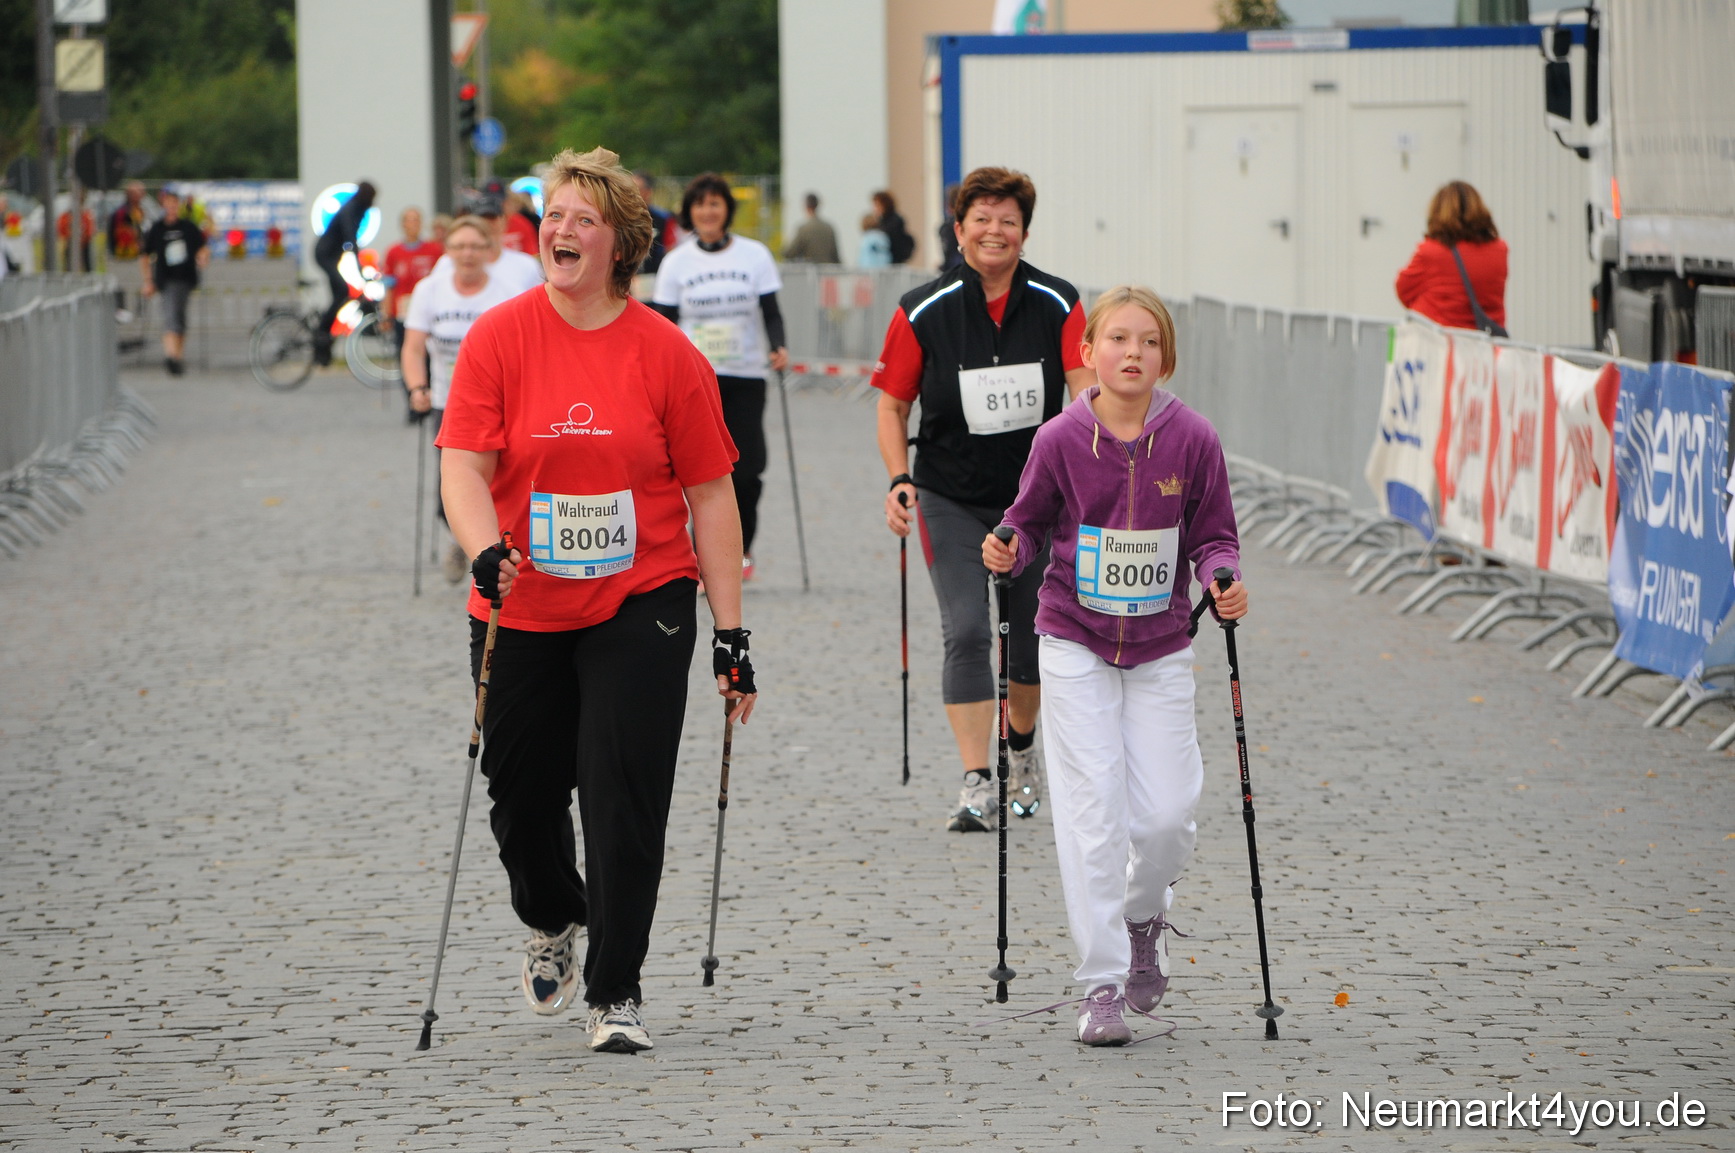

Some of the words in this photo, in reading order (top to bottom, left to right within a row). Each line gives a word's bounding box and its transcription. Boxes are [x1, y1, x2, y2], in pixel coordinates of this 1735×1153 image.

[986, 389, 1037, 411] 8115
[557, 499, 618, 518] Waltraud
[560, 524, 628, 551] 8004
[1105, 536, 1158, 553] Ramona
[596, 558, 632, 572] PFLEIDERER
[1105, 562, 1169, 587] 8006
